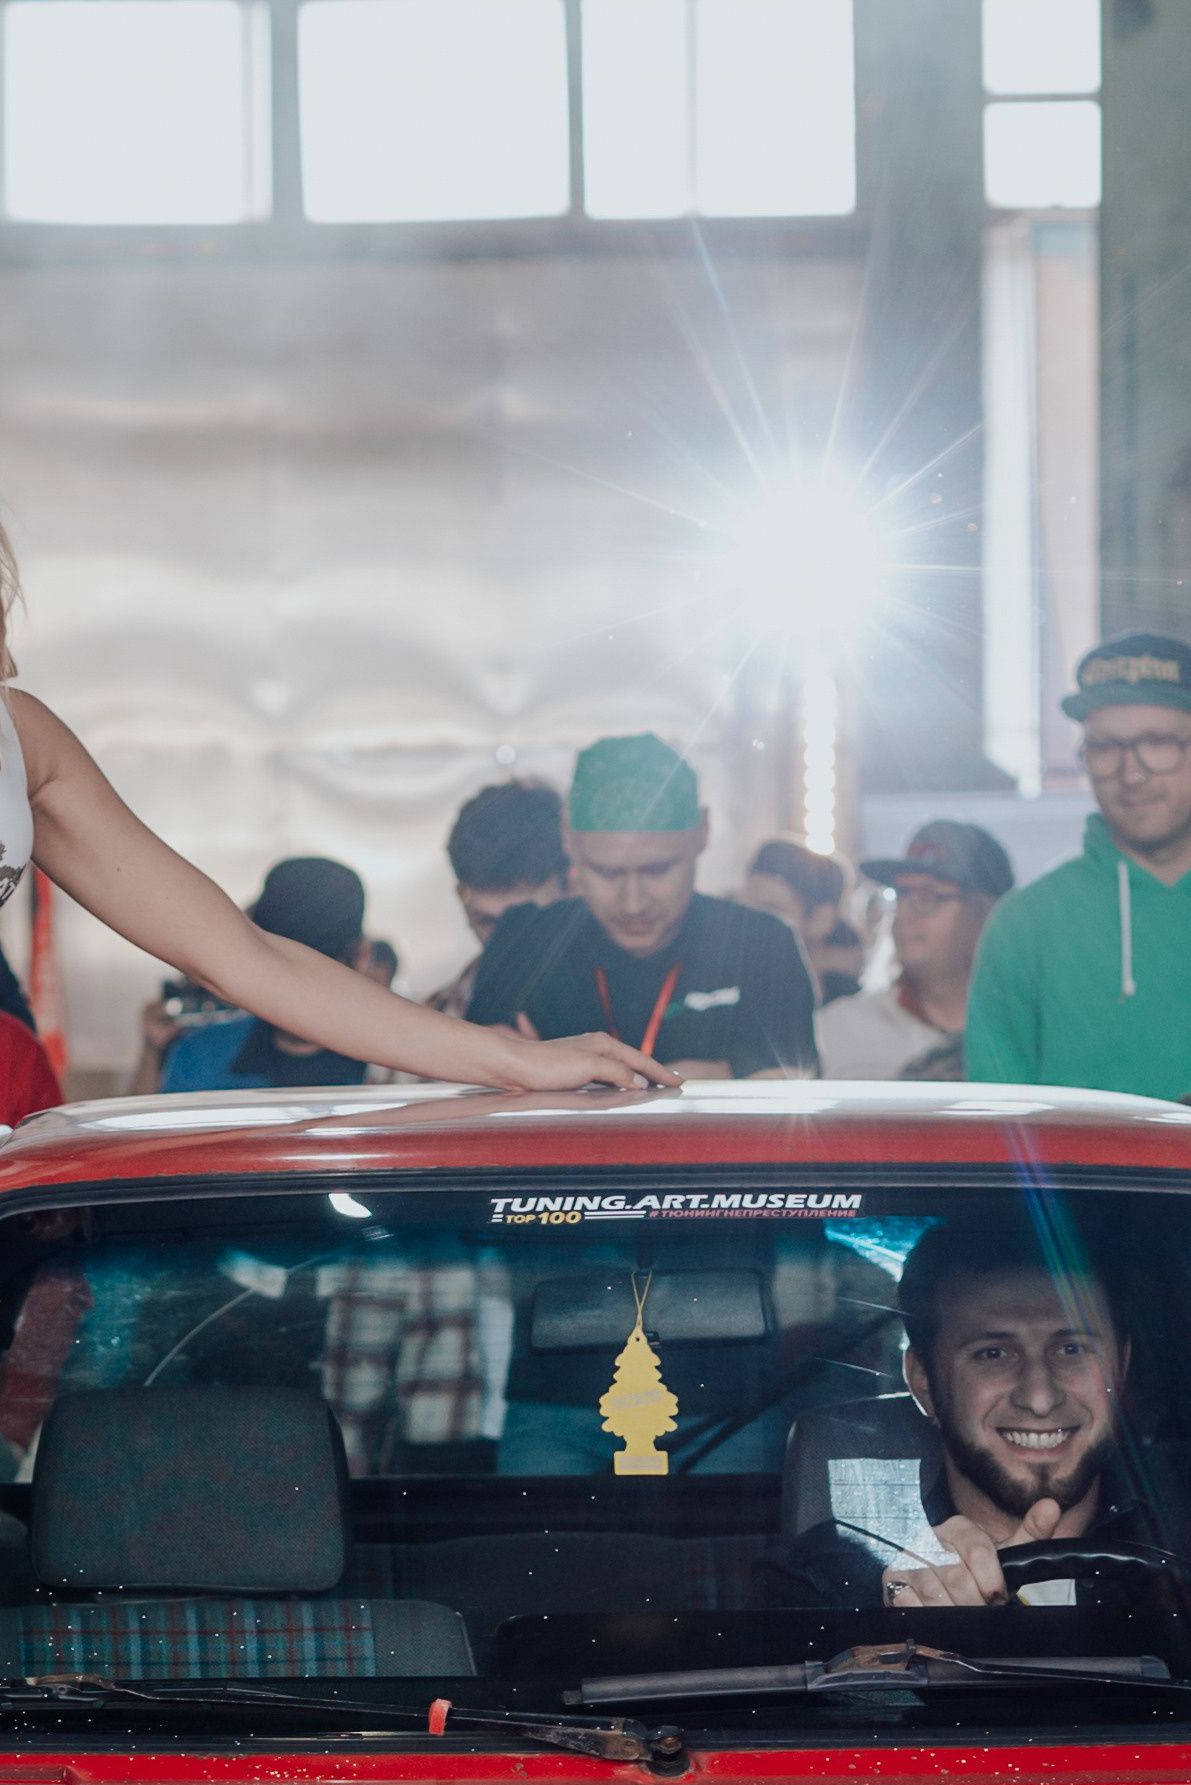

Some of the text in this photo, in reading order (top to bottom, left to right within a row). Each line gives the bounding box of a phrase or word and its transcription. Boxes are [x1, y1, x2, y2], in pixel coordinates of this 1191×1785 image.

[490, 1194, 862, 1211] TUNING.ART.MUSEUM
[506, 1211, 583, 1225] TOP 100
